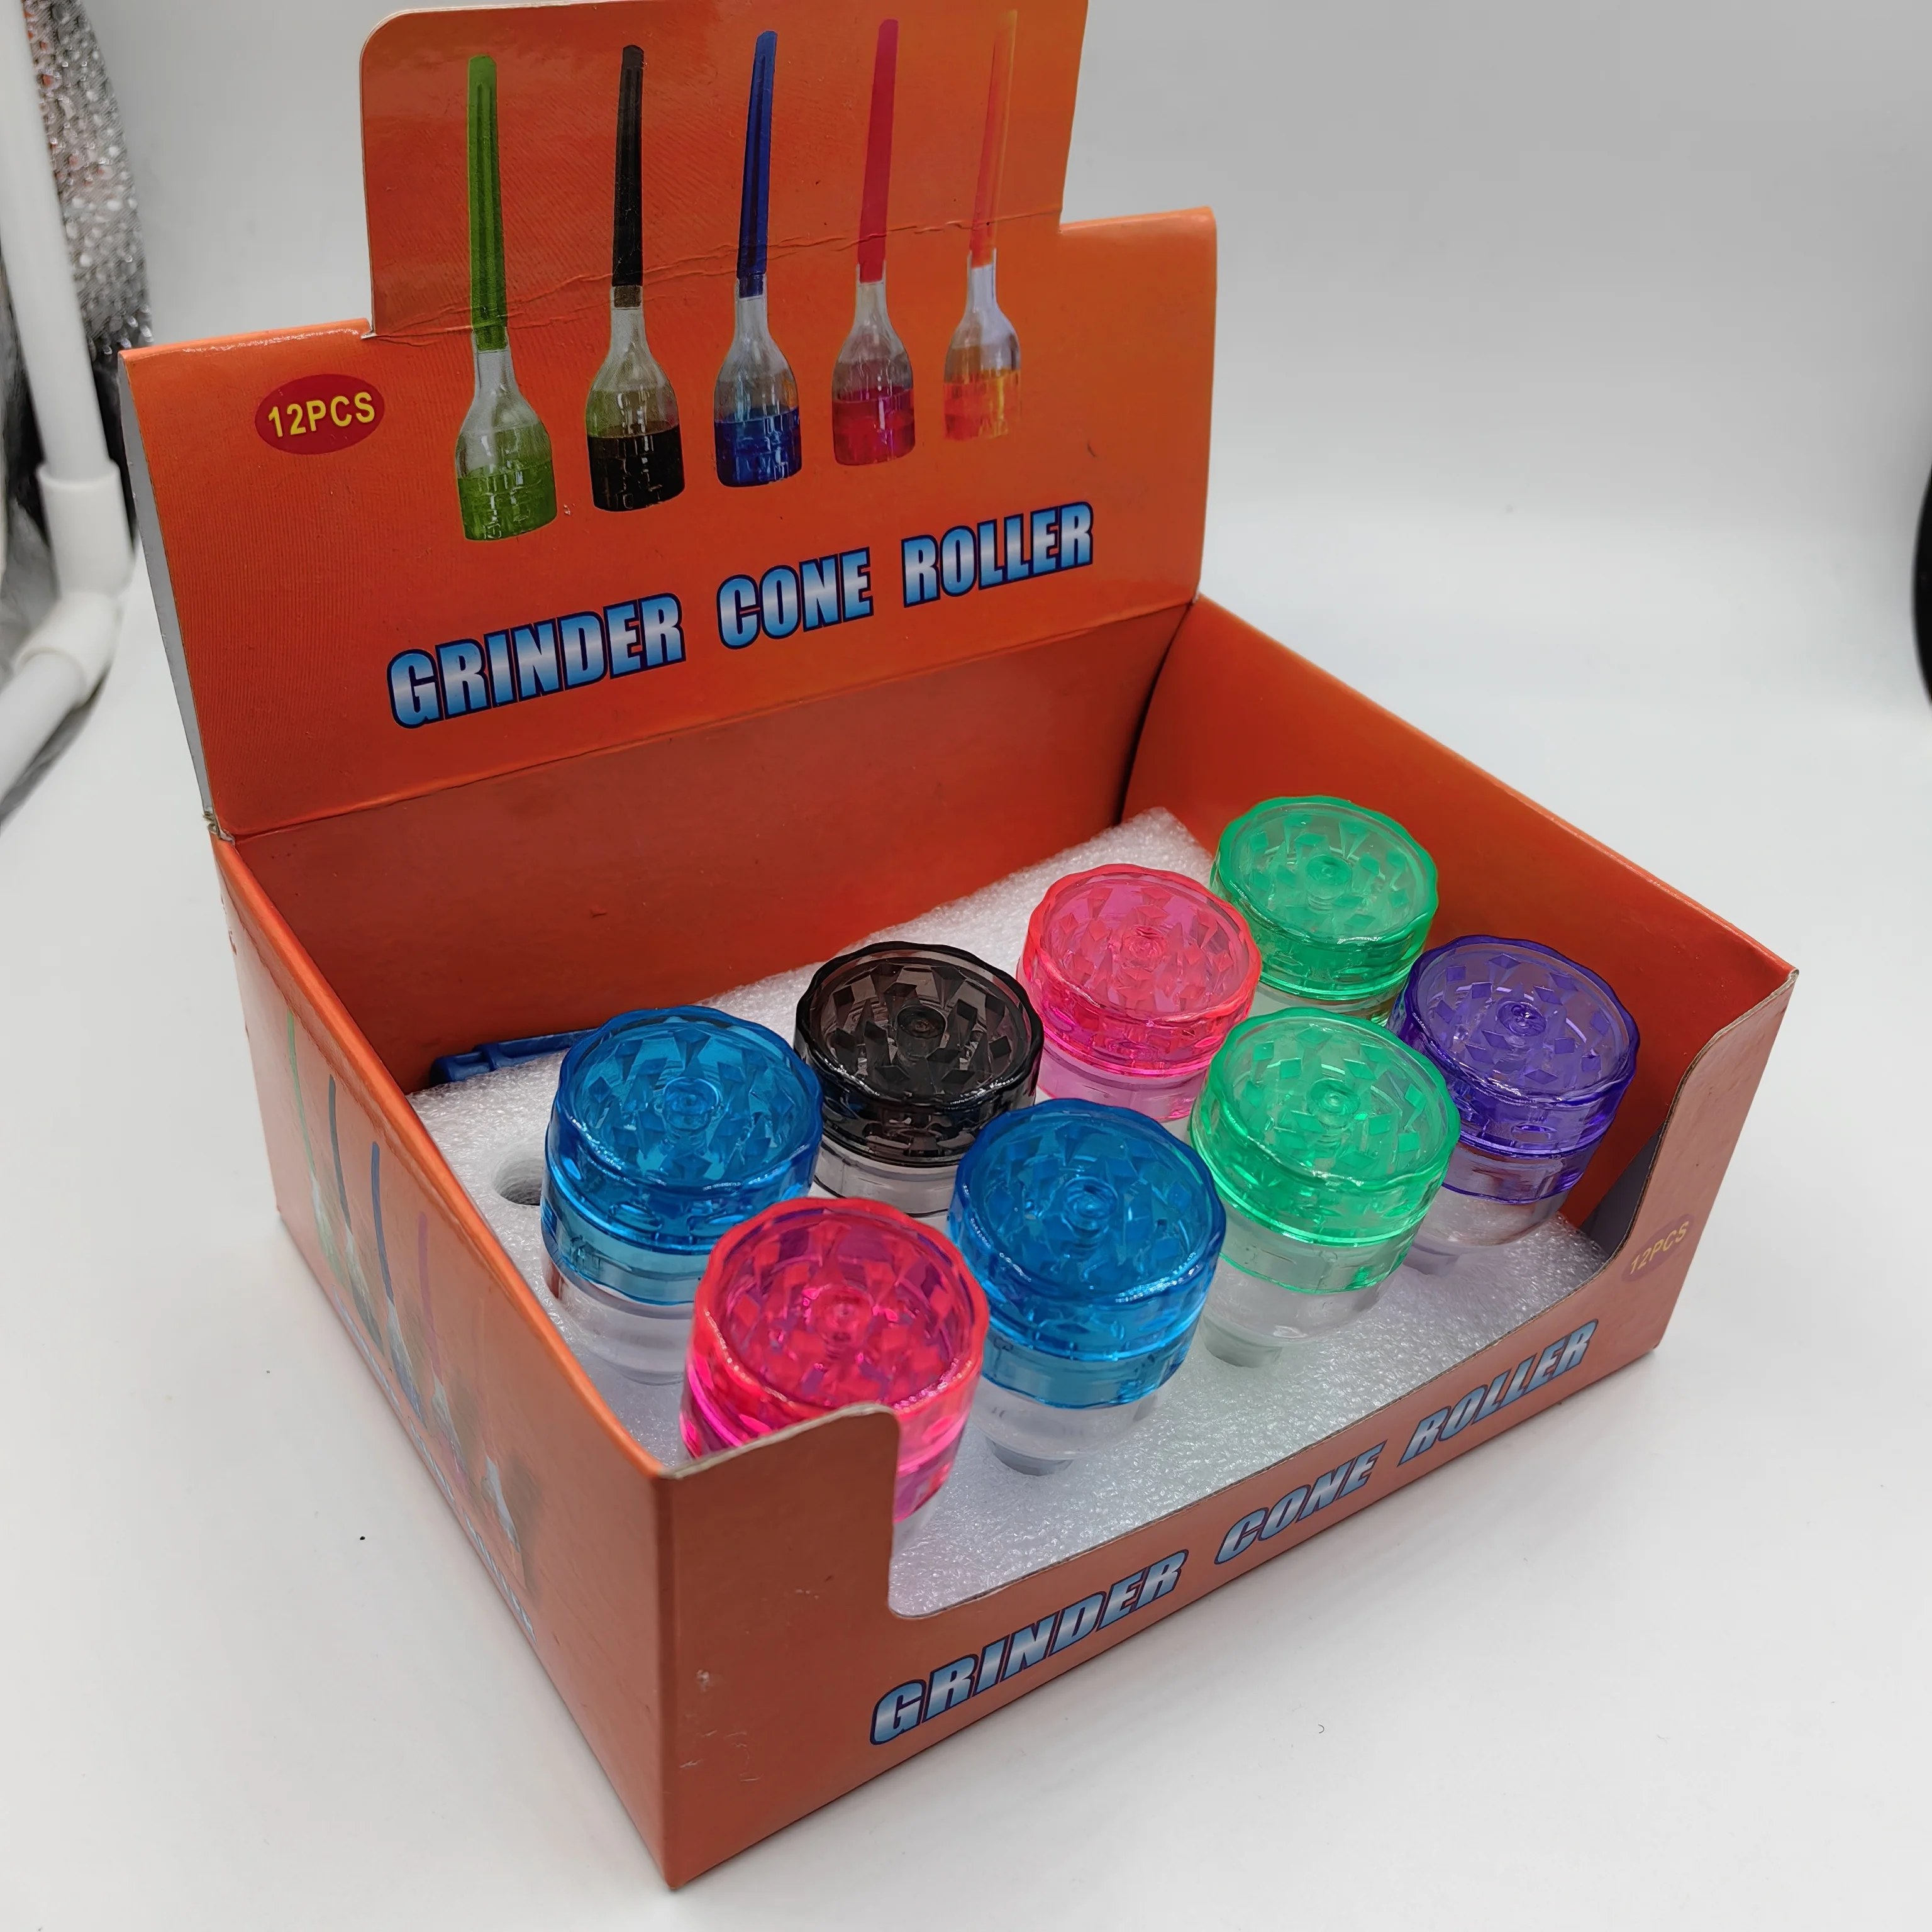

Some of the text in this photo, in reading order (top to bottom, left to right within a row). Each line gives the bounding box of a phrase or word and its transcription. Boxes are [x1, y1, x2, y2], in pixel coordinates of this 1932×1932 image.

[268, 392, 375, 437] 12PCS
[387, 501, 1094, 730] GRINDER CONE ROLLER
[1629, 1221, 1689, 1274] 12PCS
[869, 1319, 1598, 1746] GRINDER CONE ROLLER
